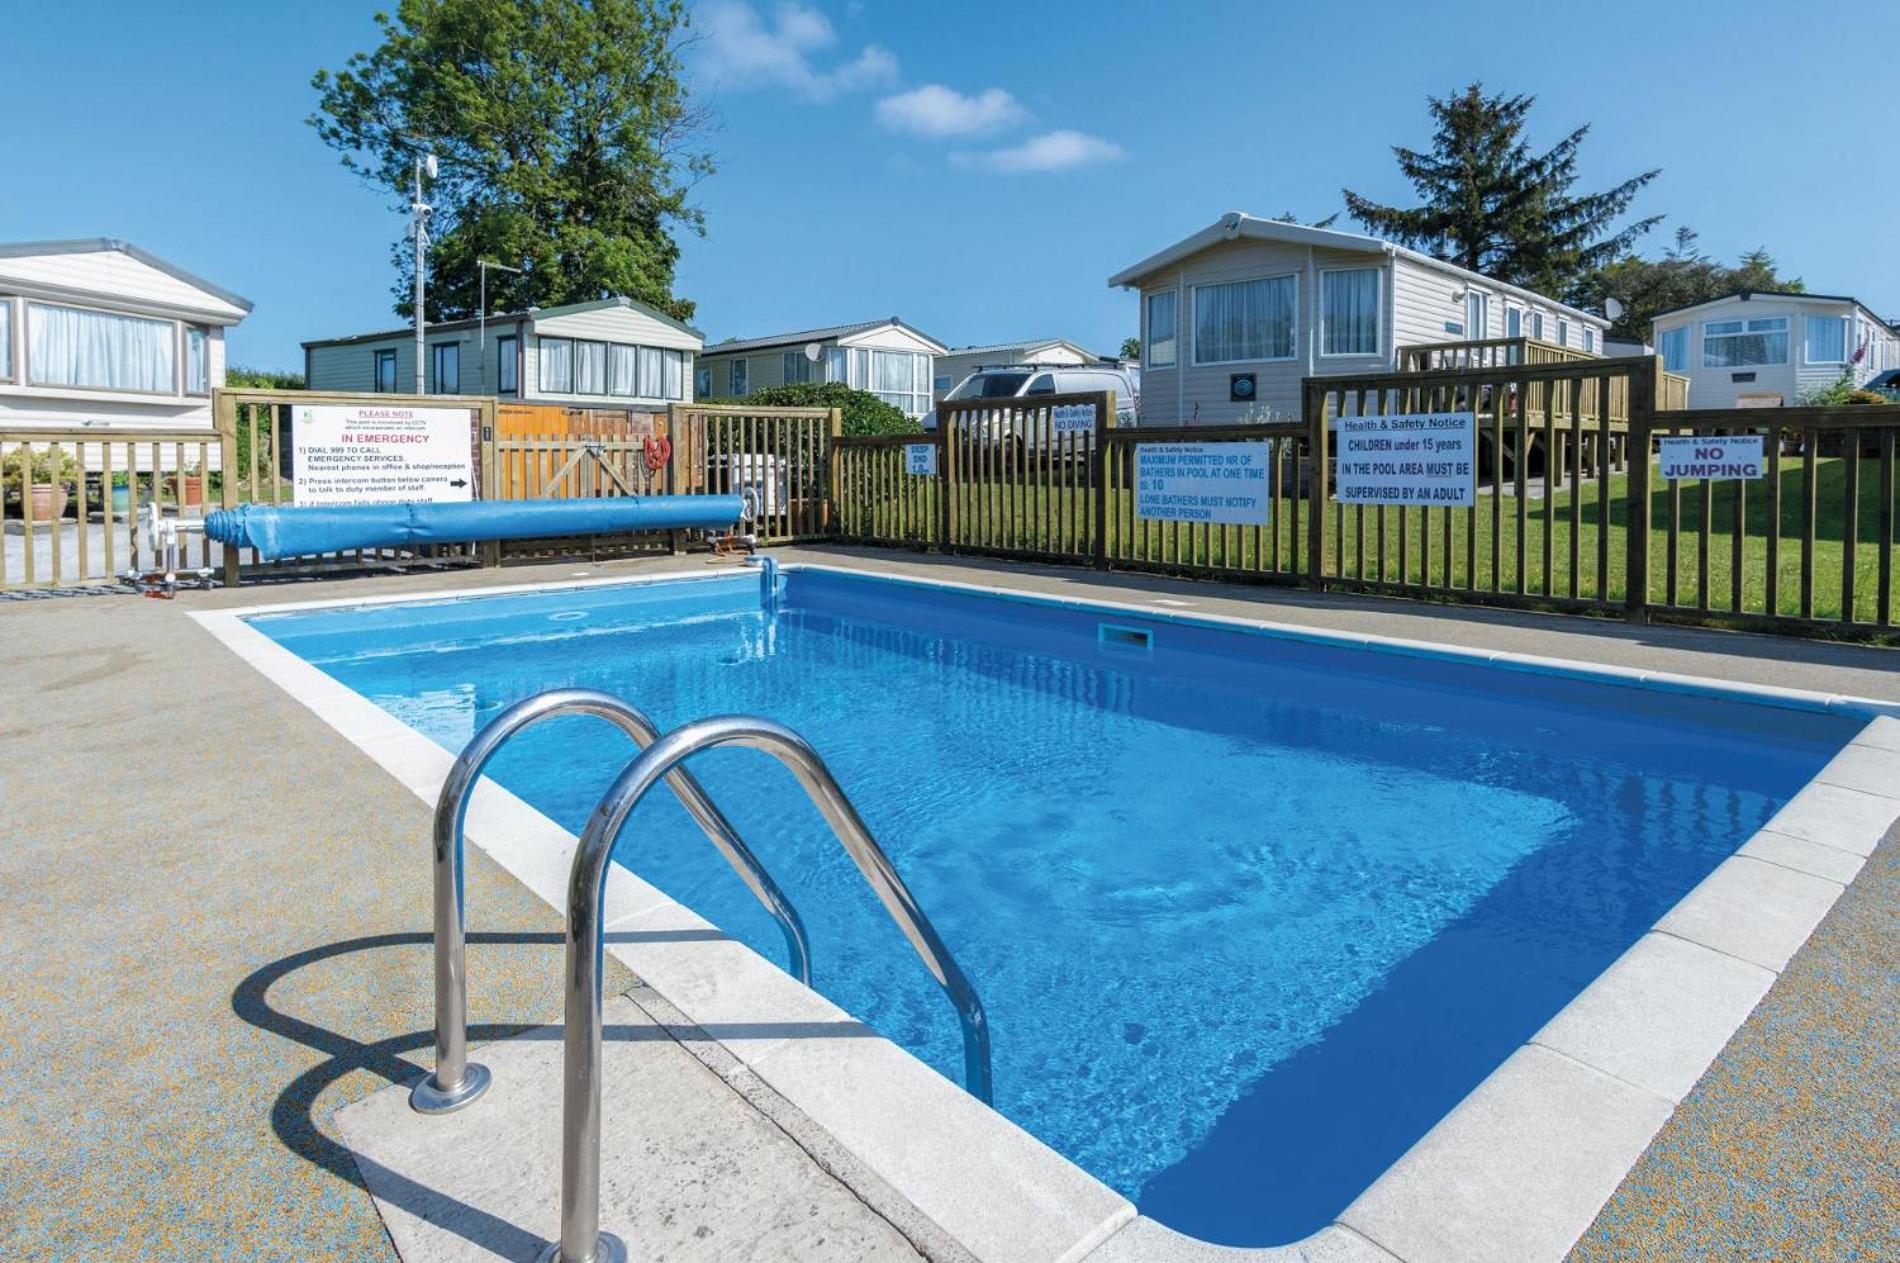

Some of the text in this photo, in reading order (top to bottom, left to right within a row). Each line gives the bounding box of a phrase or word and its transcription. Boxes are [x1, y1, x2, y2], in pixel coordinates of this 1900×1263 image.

[1067, 419, 1093, 430] DIVING
[1345, 418, 1465, 432] Health & Safety Notice
[341, 434, 430, 443] IN EMERGENCY
[1348, 438, 1462, 453] CHILDREN under 15 years
[1695, 448, 1724, 460] NO
[1140, 456, 1253, 465] MAXIMUM PERMITTED NR OF
[341, 464, 370, 472] phones
[1140, 467, 1265, 479] BATHERS IN POOL AT ONE TIME
[1342, 463, 1470, 476] IN THE POOL AREA MUST BE
[1665, 464, 1758, 477] JUMPING
[1152, 480, 1164, 490] 10
[1346, 487, 1466, 500] SUPERVISED BY AN ADULT
[1163, 495, 1199, 505] BATHERS
[1201, 496, 1223, 507] MUST
[1225, 498, 1257, 508] NOTIFY
[1140, 507, 1212, 519] ANOTHER PERSON
